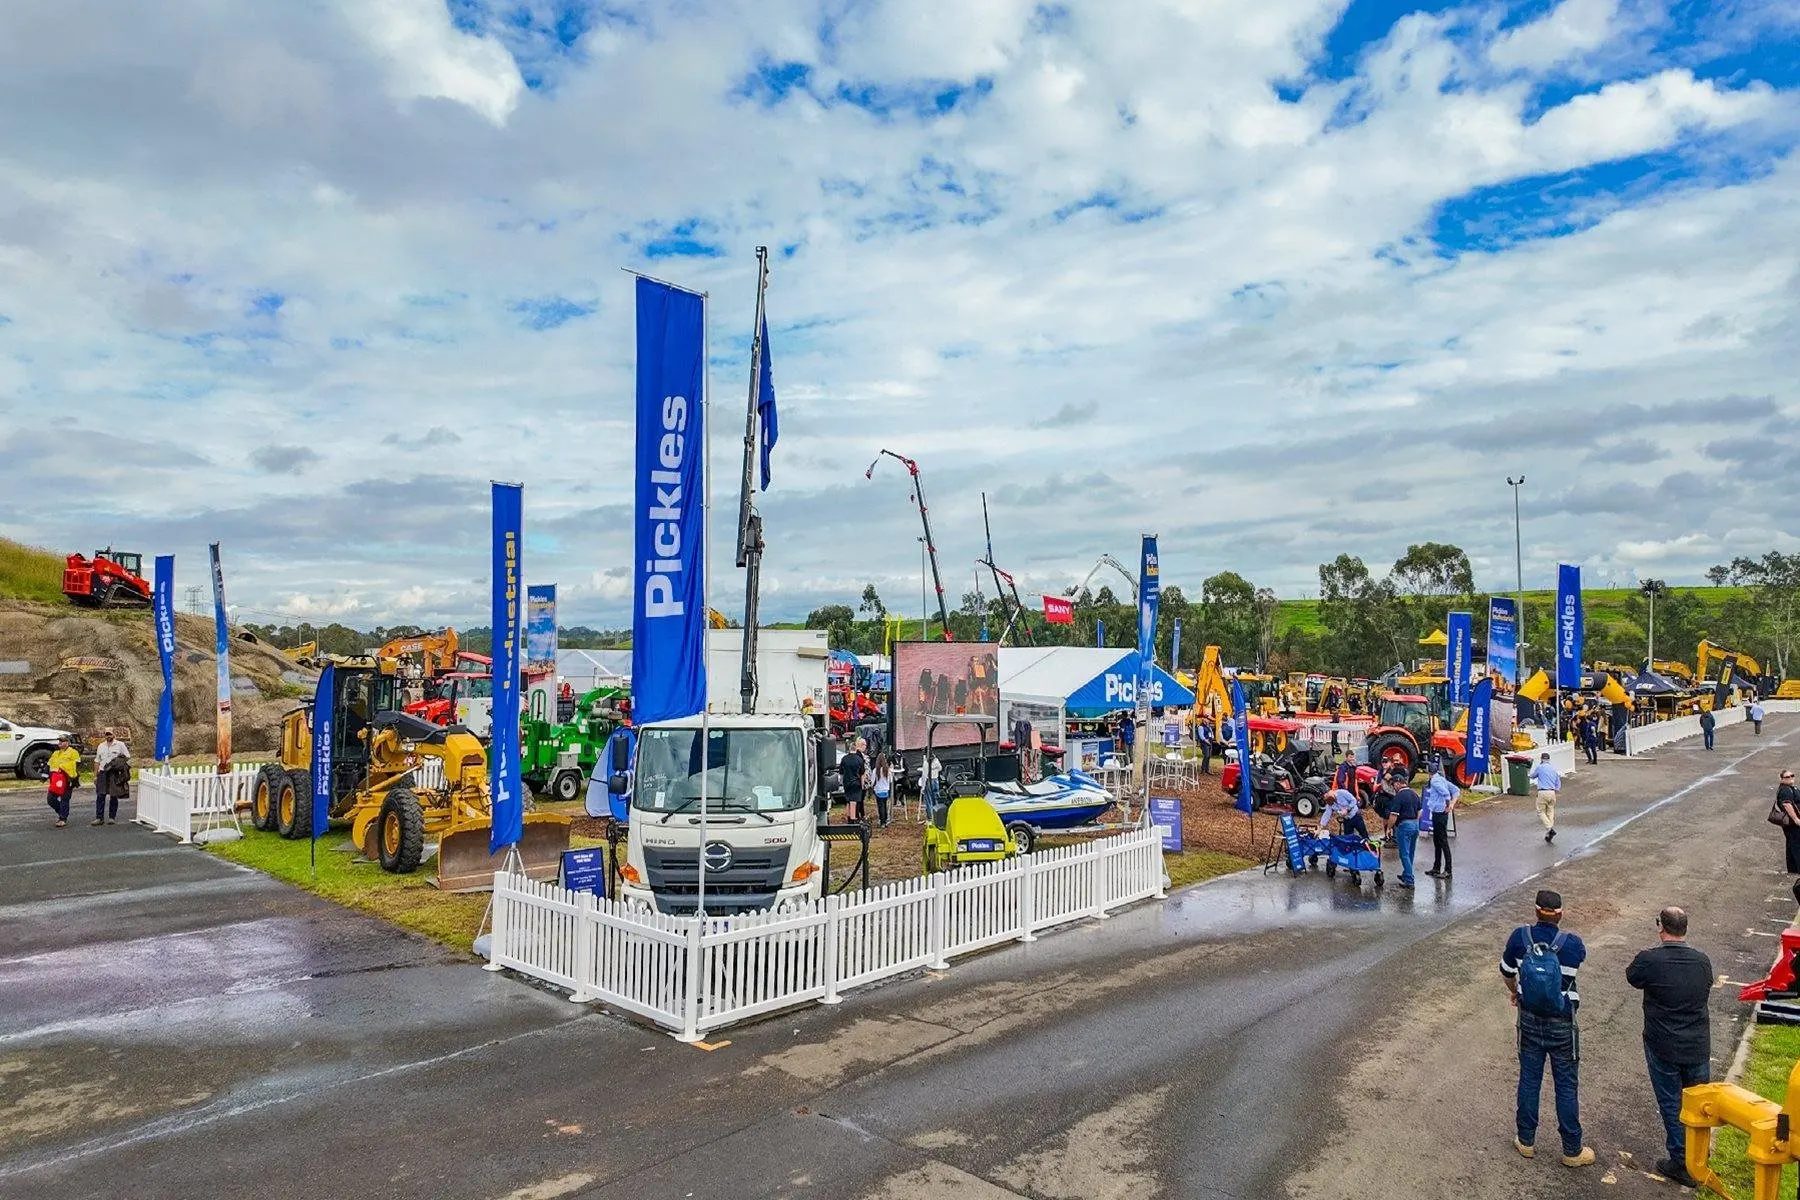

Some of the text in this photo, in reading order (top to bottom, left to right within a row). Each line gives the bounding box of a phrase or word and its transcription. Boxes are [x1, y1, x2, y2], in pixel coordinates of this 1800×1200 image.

[644, 396, 687, 619] Pickles
[1047, 603, 1070, 615] SANY
[1561, 594, 1575, 659] Pickles
[400, 641, 424, 652] CASE
[1453, 628, 1463, 679] Industrial
[828, 659, 848, 670] ANY
[1105, 673, 1163, 703] Pics
[1473, 706, 1484, 759] Pickles
[763, 837, 787, 845] 500
